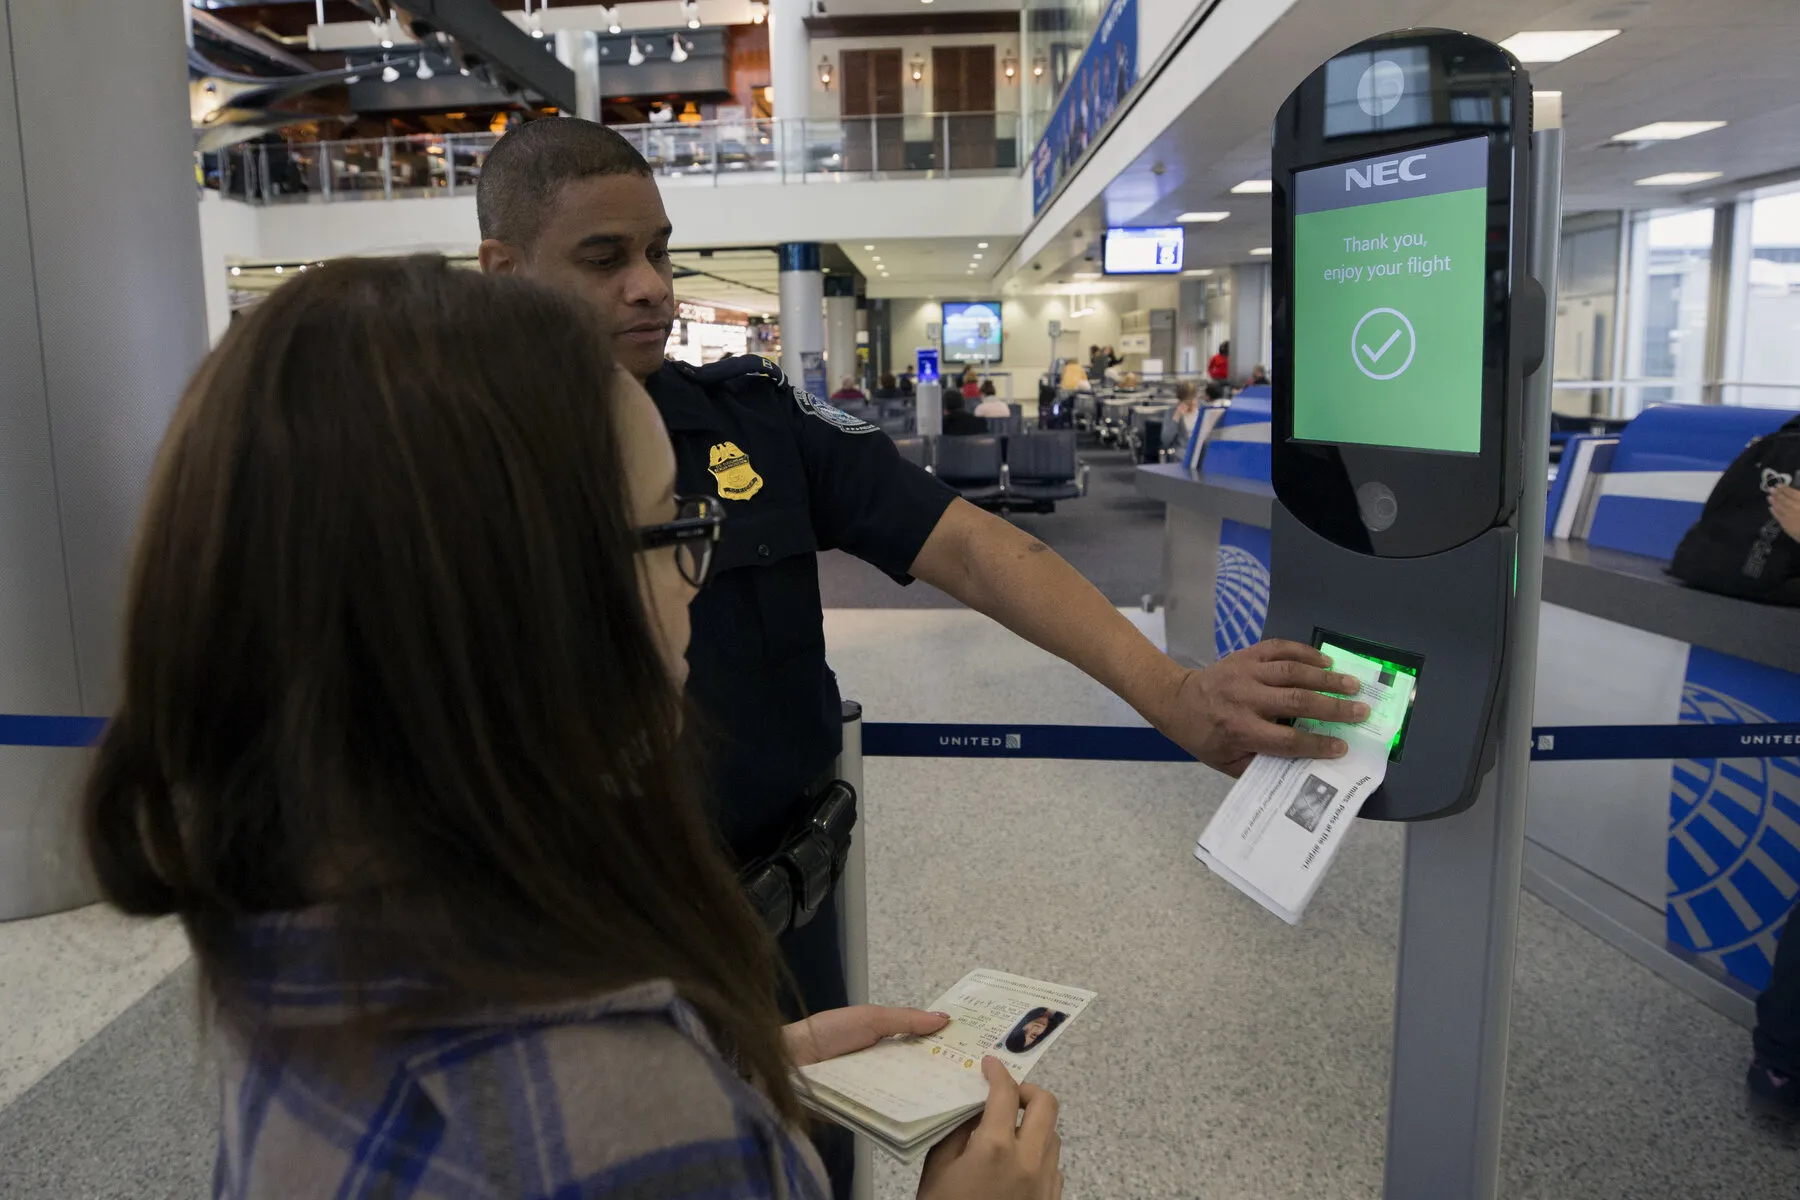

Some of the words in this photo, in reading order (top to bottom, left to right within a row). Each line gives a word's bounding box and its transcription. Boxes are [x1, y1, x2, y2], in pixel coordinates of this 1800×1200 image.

[1345, 154, 1427, 192] NEC
[1343, 233, 1389, 253] Thank
[1393, 233, 1428, 253] you,
[1323, 263, 1363, 285] enjoy
[1367, 261, 1404, 282] your
[1407, 254, 1452, 278] flight
[939, 736, 1002, 747] UNITED
